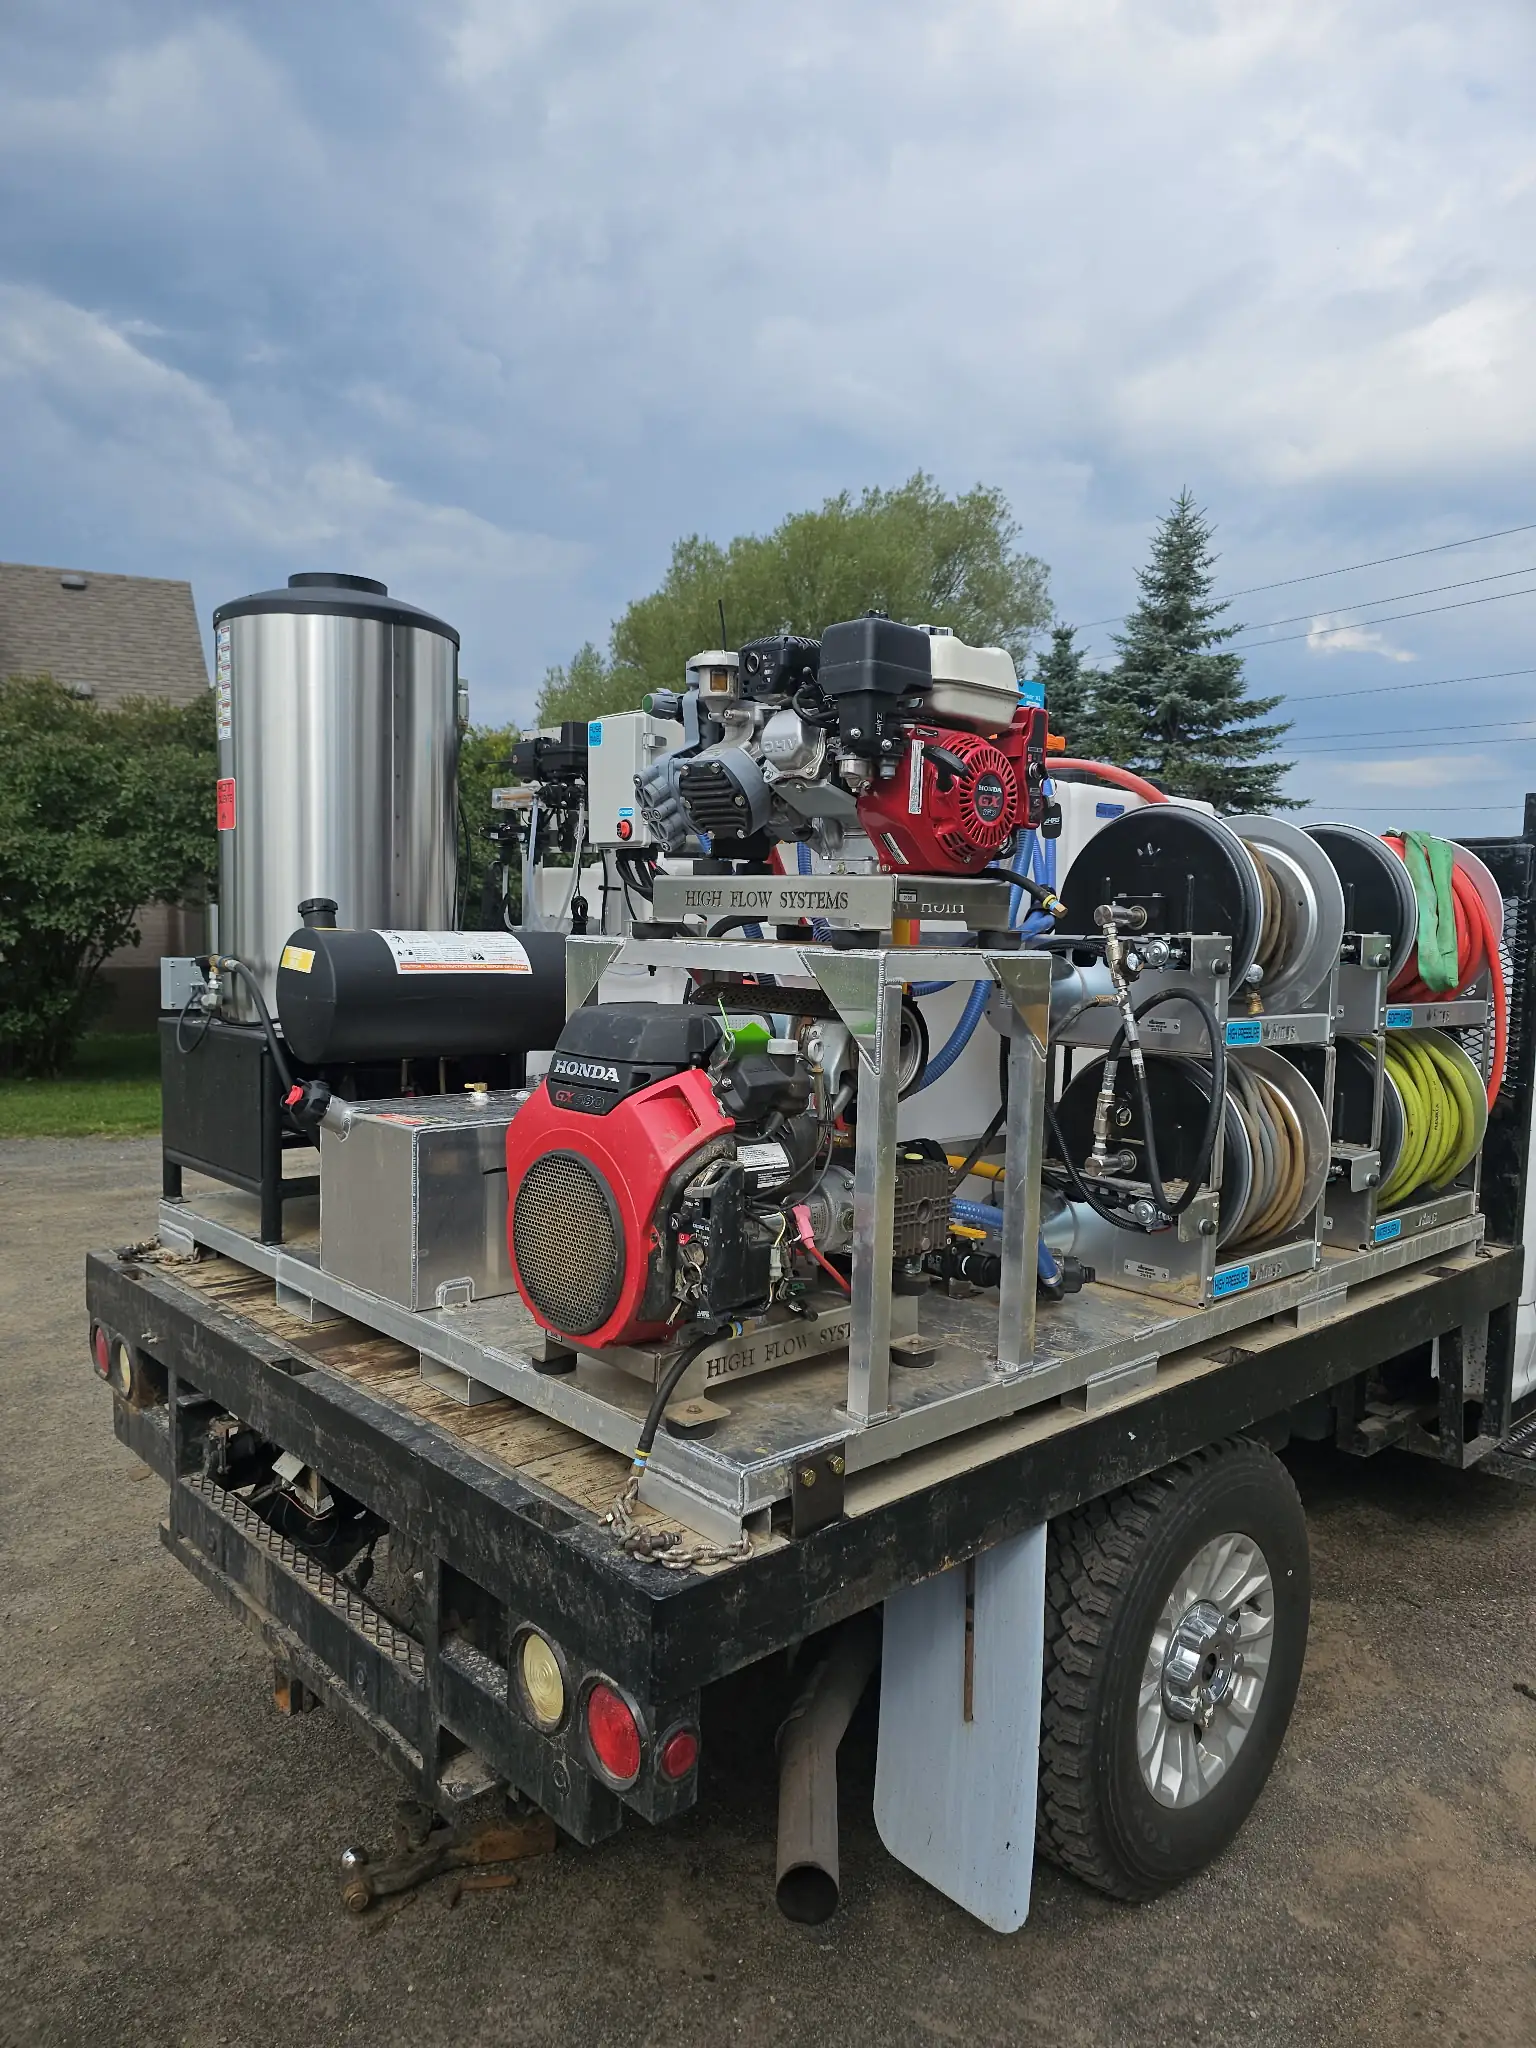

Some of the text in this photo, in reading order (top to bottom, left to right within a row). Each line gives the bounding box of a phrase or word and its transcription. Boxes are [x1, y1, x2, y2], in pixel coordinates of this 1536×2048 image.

[978, 784, 1003, 793] HONDA
[977, 795, 1000, 808] GX
[685, 890, 849, 910] HIGH FLOW SYSTEMS
[553, 1060, 620, 1082] HONDA
[556, 1090, 575, 1103] GX
[706, 1348, 756, 1379] HIGH
[764, 1334, 808, 1362] FLOW
